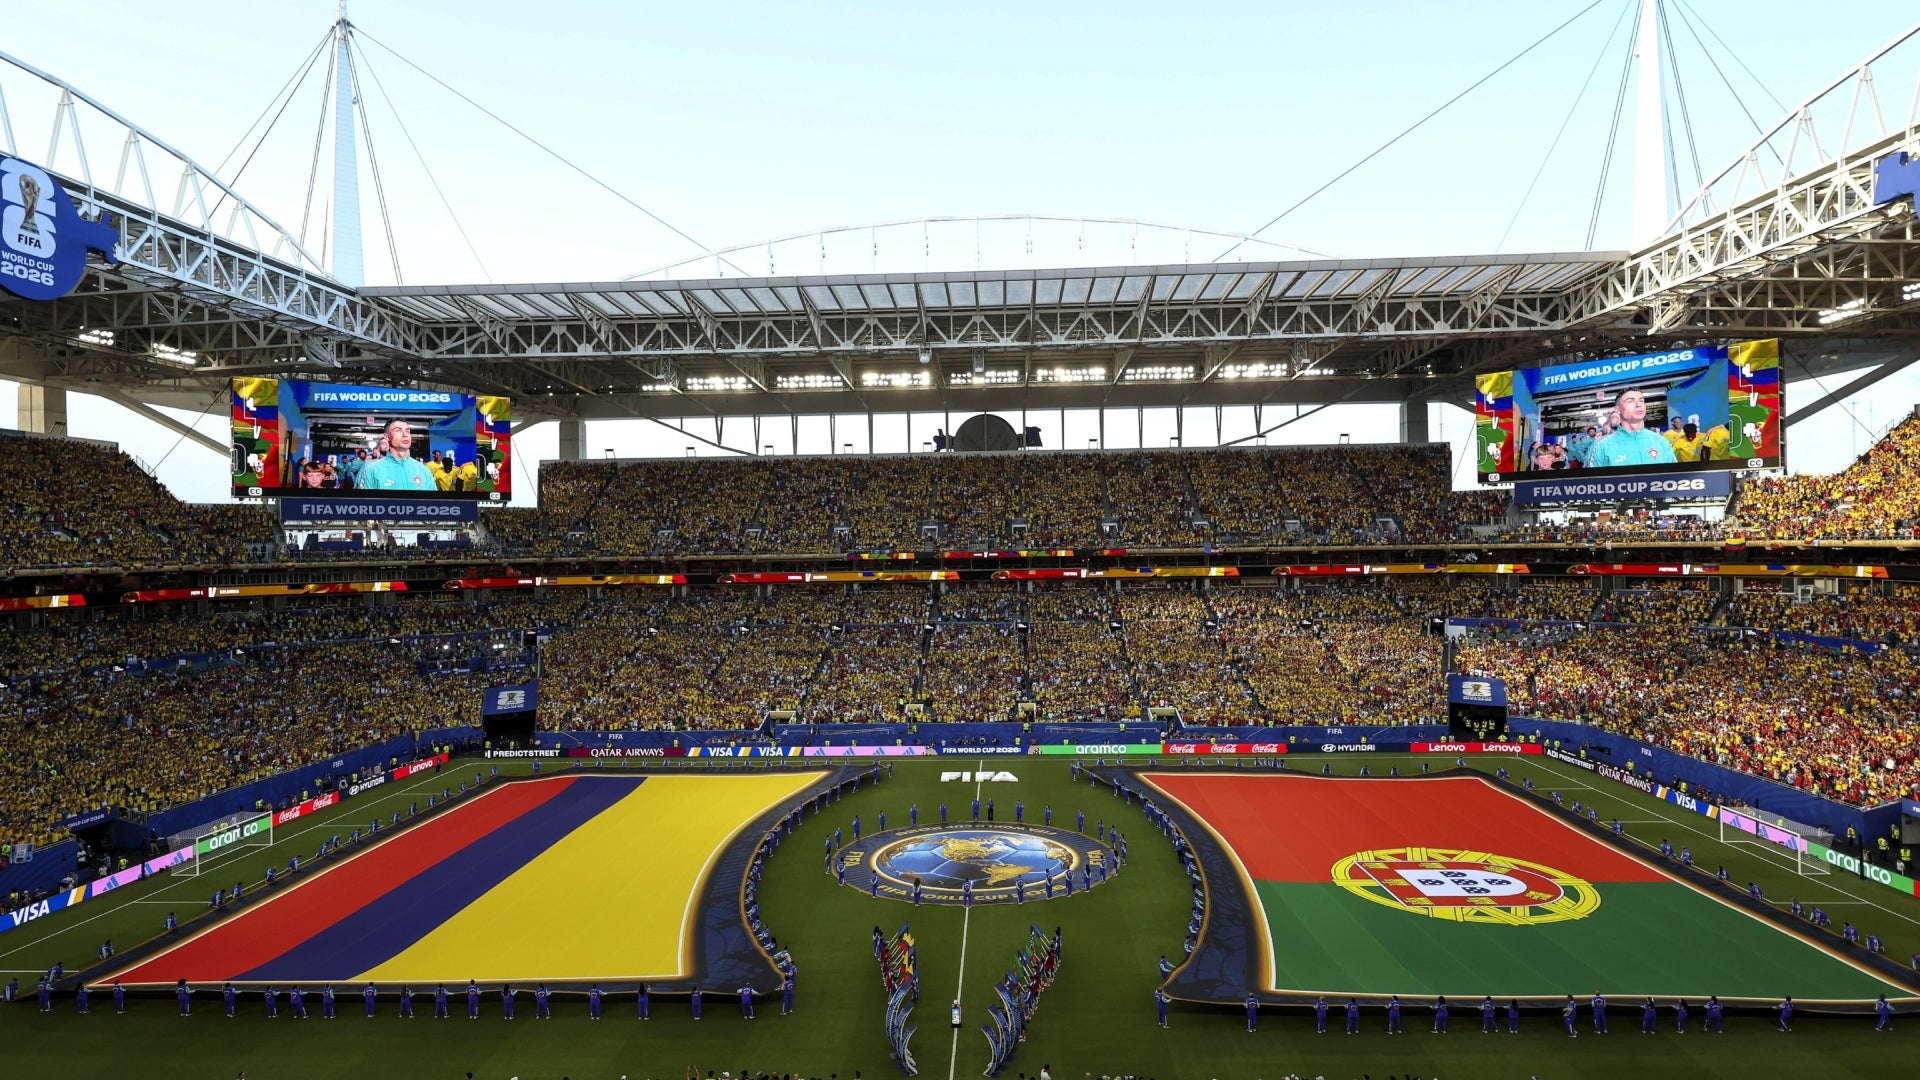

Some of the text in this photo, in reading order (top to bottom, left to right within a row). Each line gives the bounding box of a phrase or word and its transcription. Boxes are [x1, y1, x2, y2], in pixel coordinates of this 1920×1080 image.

[17, 233, 42, 249] FIFA
[1, 250, 55, 273] WORLD CUP
[0, 261, 55, 287] 2026
[1544, 350, 1694, 386] FIFA WORLD CUP 2026
[314, 392, 451, 403] FIFA WORLD CUP 2026
[1533, 478, 1706, 498] FIFA WORLD CUP 2026
[302, 503, 461, 516] FIFA WORLD CUP 2026
[493, 749, 560, 758] PREDICTSTREET
[590, 748, 664, 758] QATAR AIRWAYS
[707, 747, 733, 757] VISA
[757, 747, 783, 757] VISA
[1075, 745, 1127, 754] aramco
[1169, 744, 1197, 754] Coca-Cola
[1210, 744, 1238, 754] Coca-Cola
[1251, 744, 1279, 754] Coca-Cola
[1337, 744, 1376, 752] HYUNDAI
[1428, 743, 1466, 752] Lenovo
[1482, 743, 1522, 753] Lenovo
[1641, 747, 1653, 757] FIFA
[333, 759, 344, 769] FIFA
[408, 760, 433, 775] Lenovo
[940, 771, 1019, 783] FIFA
[1598, 765, 1652, 793] QATAR AIRWAYS
[360, 776, 385, 792] HYUNDAI
[312, 793, 333, 811] Coca-Cola
[1674, 792, 1697, 812] VISA
[278, 805, 301, 824] Coca-Cola
[1825, 849, 1892, 885] aramco
[8, 899, 50, 926] VISA
